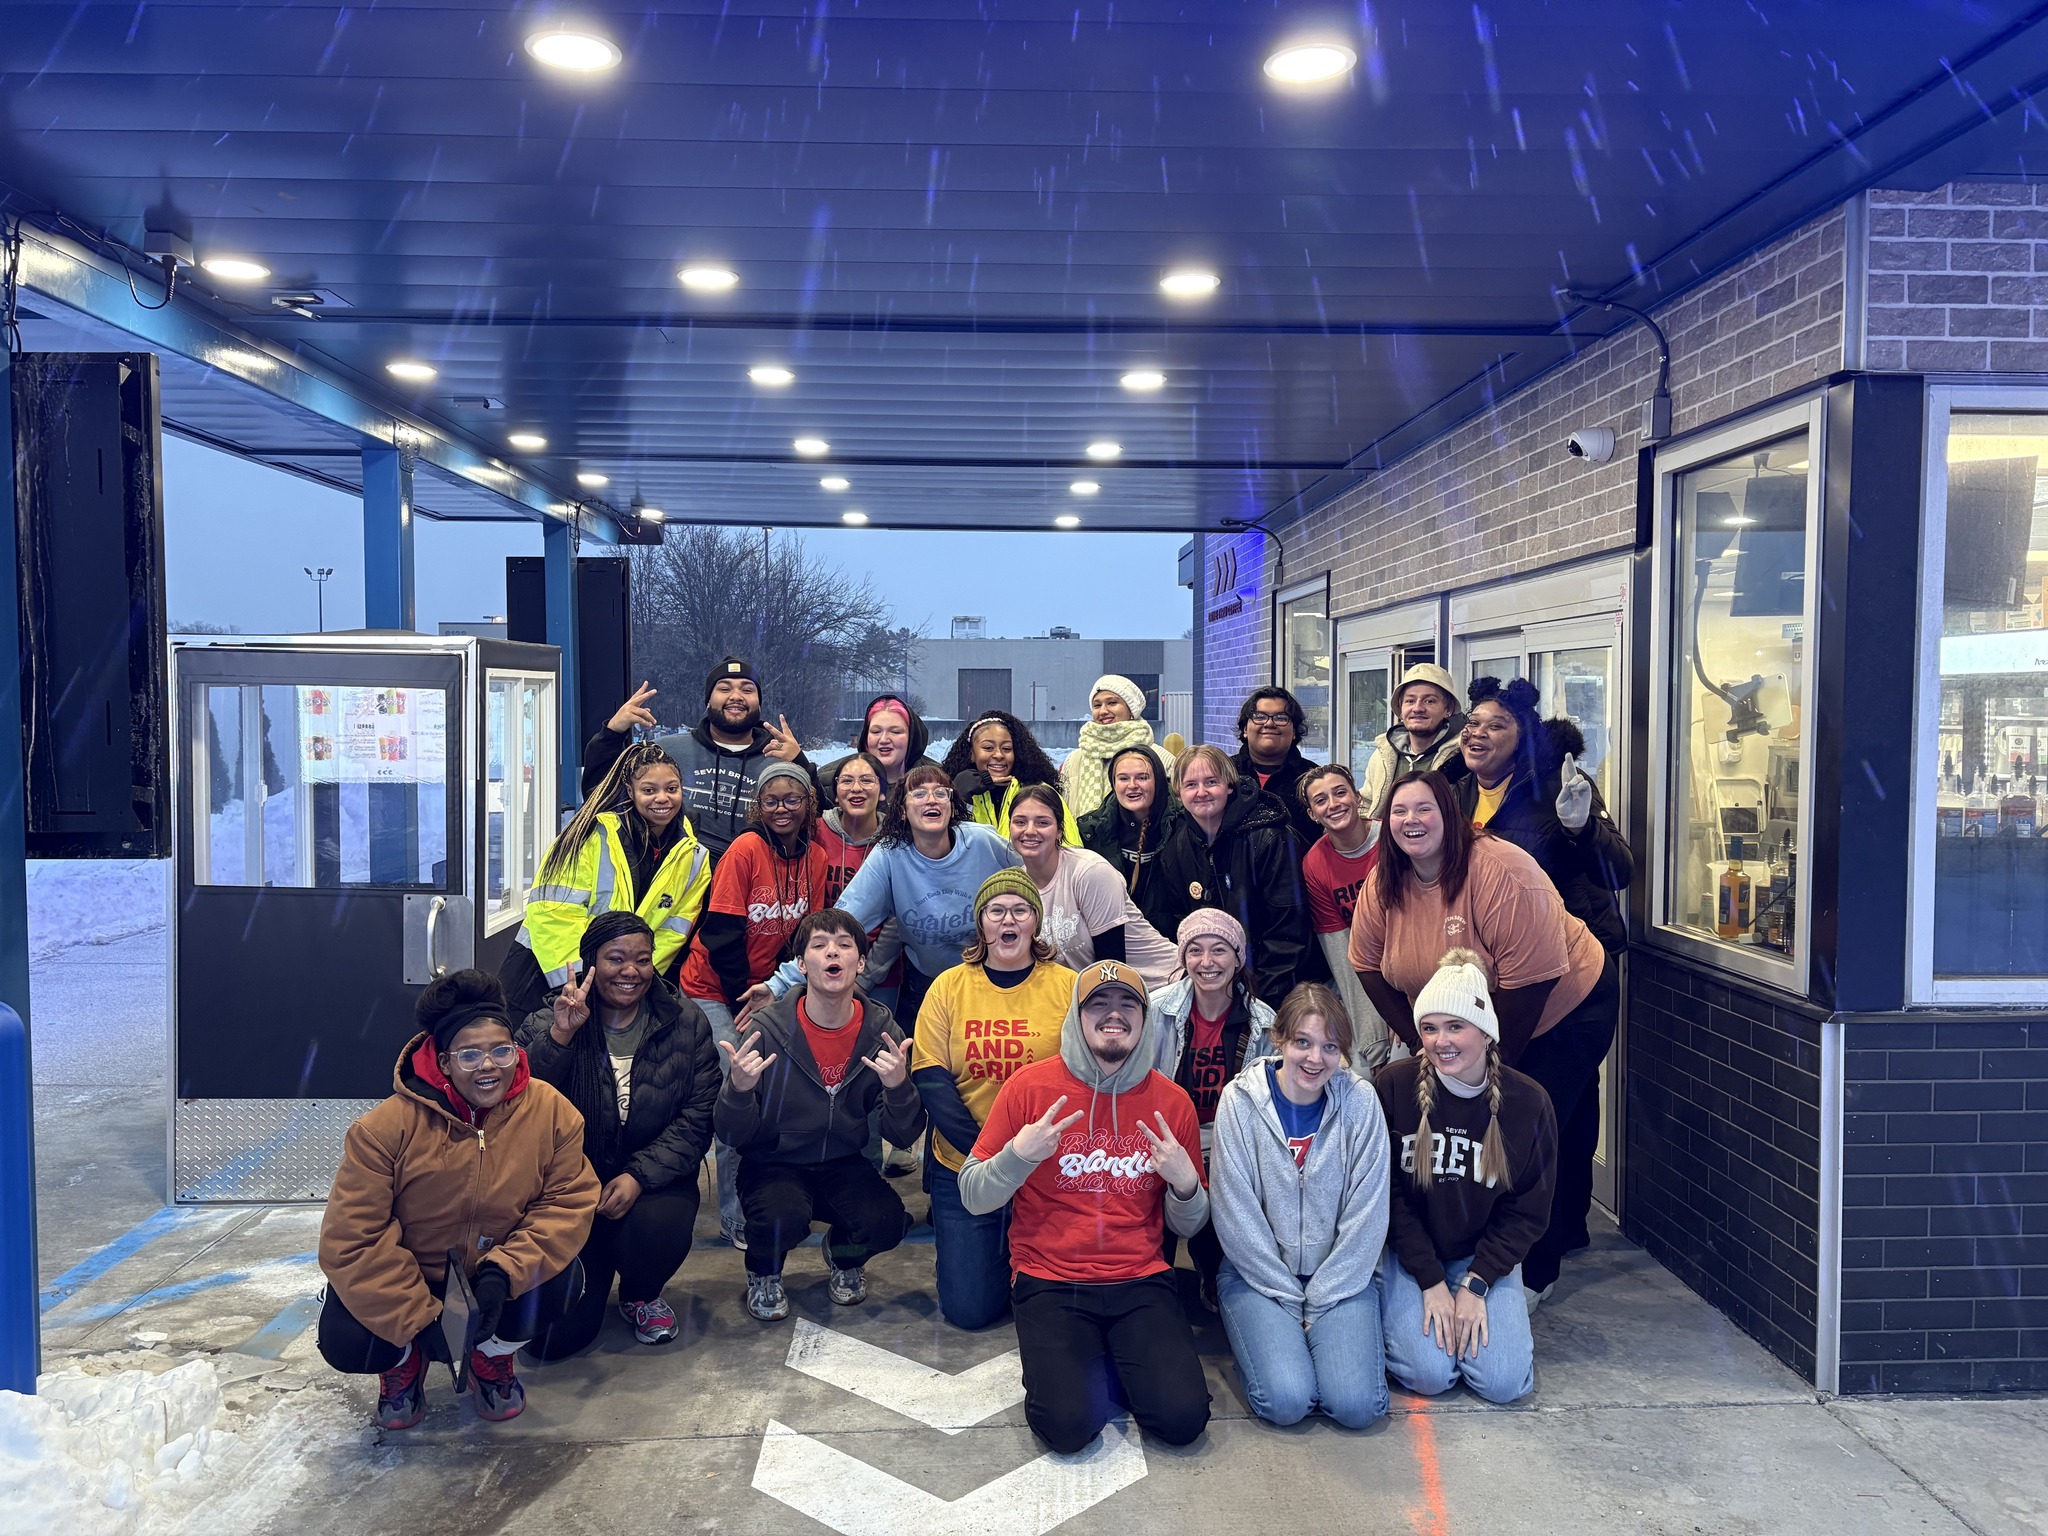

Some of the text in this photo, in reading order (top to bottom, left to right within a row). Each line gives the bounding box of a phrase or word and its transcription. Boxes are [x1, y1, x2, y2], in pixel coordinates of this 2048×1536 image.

[694, 768, 756, 785] SEVEN BREW
[724, 809, 744, 818] COEE
[827, 864, 856, 884] RIS
[914, 895, 929, 906] Start
[926, 890, 942, 900] Each
[942, 887, 954, 896] Day
[954, 889, 968, 899] With
[1333, 878, 1366, 906] RIS
[901, 904, 976, 935] Gratef
[1100, 963, 1119, 981] NY
[964, 1018, 1031, 1040] RISE
[964, 1038, 1025, 1062] AND
[1190, 1045, 1226, 1067] ISE
[968, 1060, 1024, 1081] GRI
[1193, 1067, 1221, 1089] ND
[1192, 1089, 1219, 1108] RIN
[1059, 1128, 1153, 1155] Blondi
[1445, 1126, 1468, 1135] SEVEN
[1058, 1148, 1156, 1179] Blondie
[1054, 1170, 1155, 1197] Blondie
